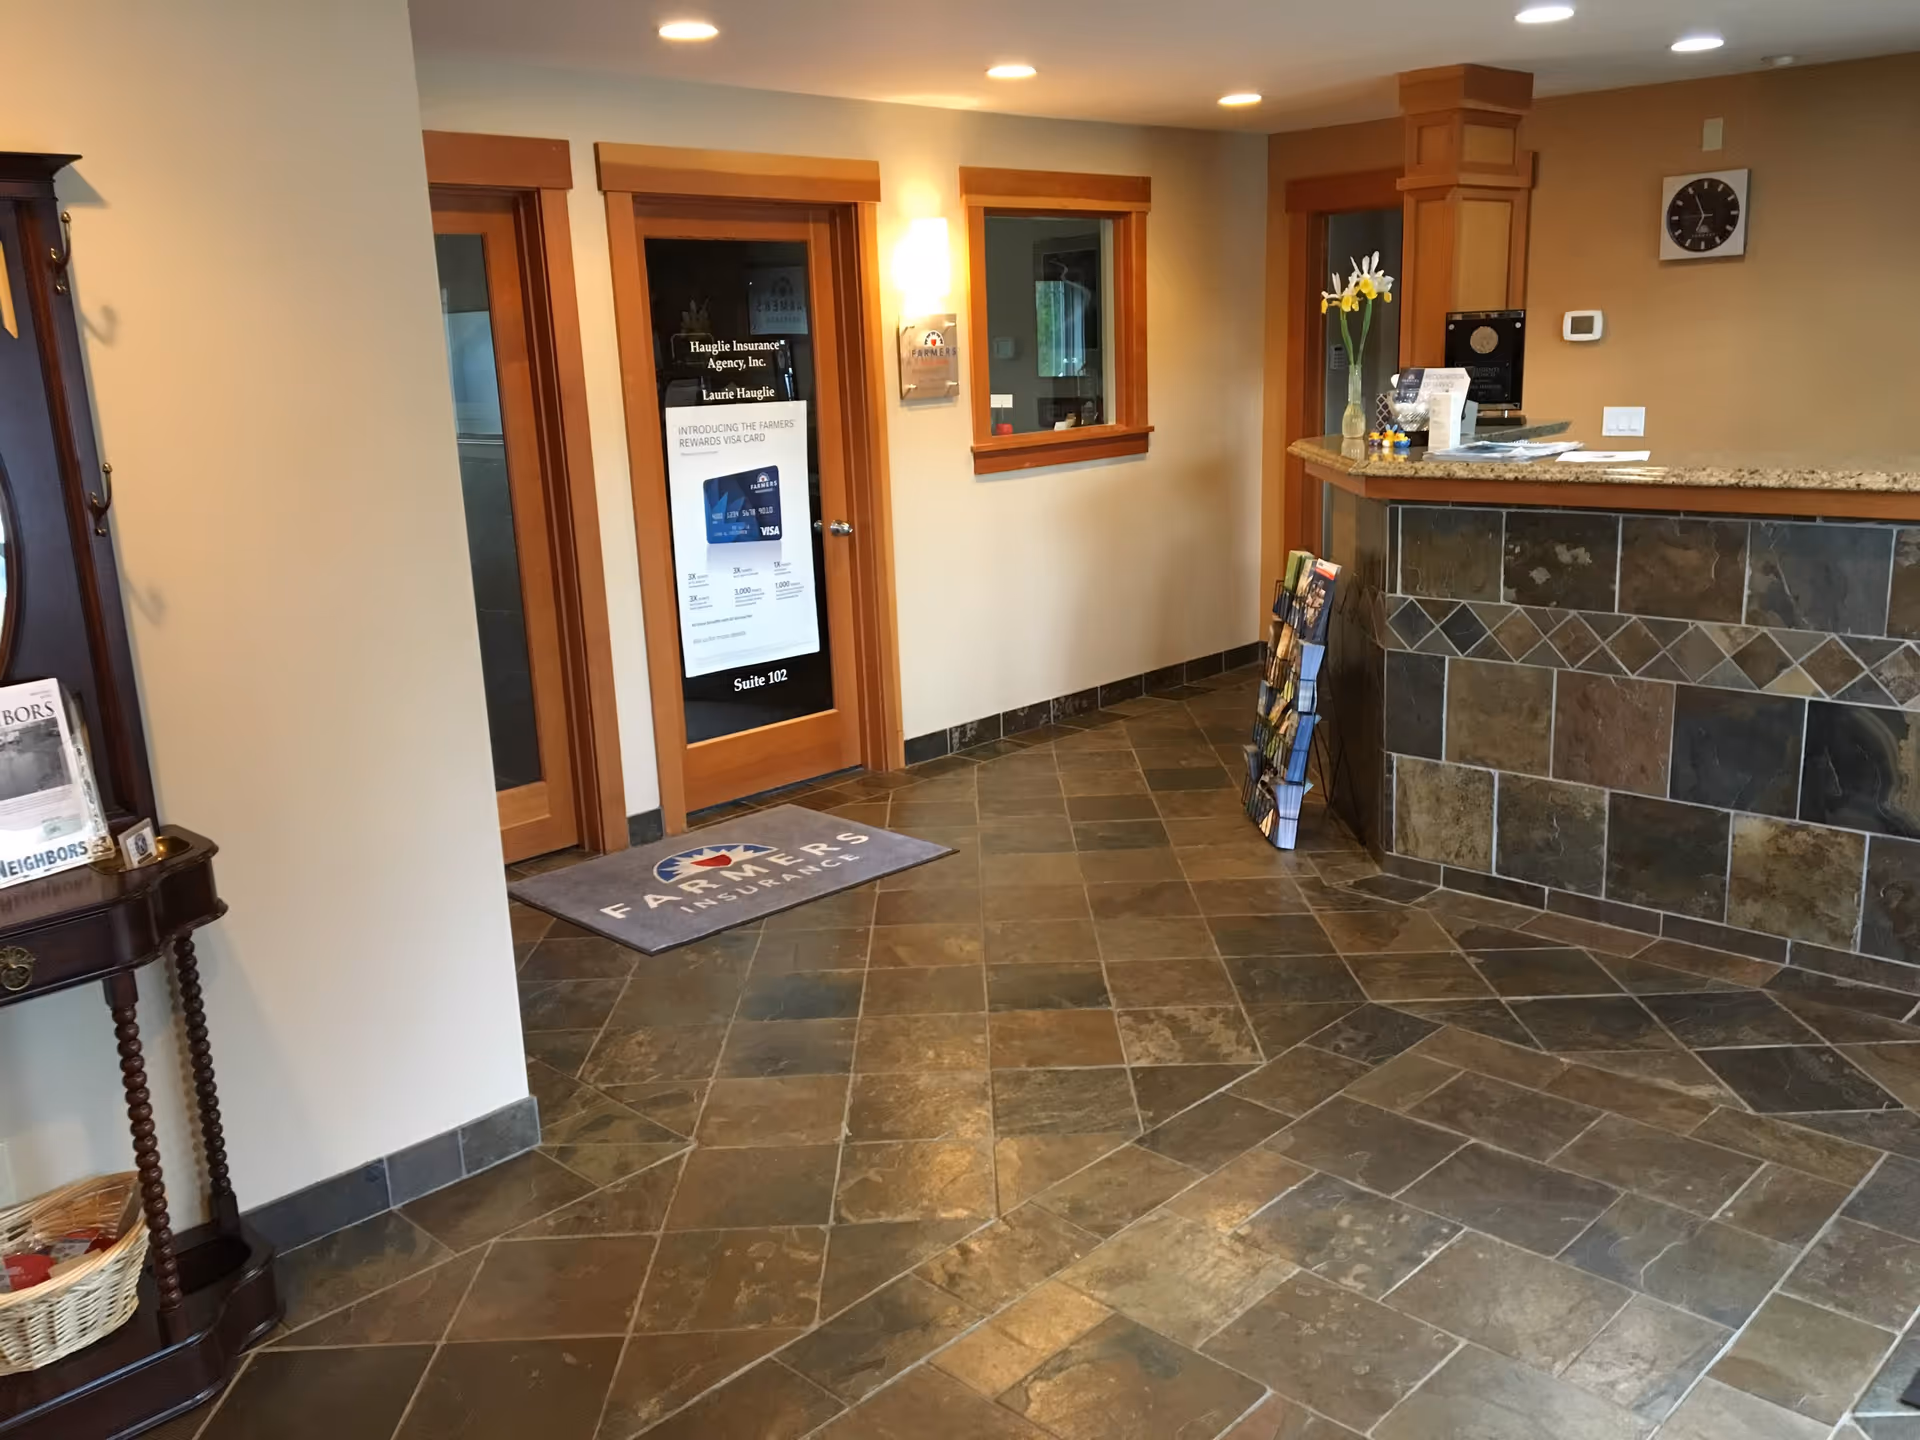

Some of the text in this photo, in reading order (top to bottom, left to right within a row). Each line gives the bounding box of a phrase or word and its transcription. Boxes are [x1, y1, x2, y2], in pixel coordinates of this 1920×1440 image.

[689, 339, 780, 355] Hauglie Insurance
[911, 347, 957, 358] FARMERS
[707, 356, 767, 372] Agency, Inc.
[702, 386, 775, 401] Laurie Hauglie
[678, 422, 740, 435] INTRODUCING
[741, 422, 757, 431] THE
[679, 433, 766, 448] REWARDS VISA CARD
[750, 480, 777, 490] FARMERS
[760, 525, 780, 536] VISA
[733, 669, 789, 692] Suite 102
[0, 841, 88, 878] NEIGHBORS
[600, 831, 871, 920] FARMERS
[680, 853, 860, 914] INSURANCE
